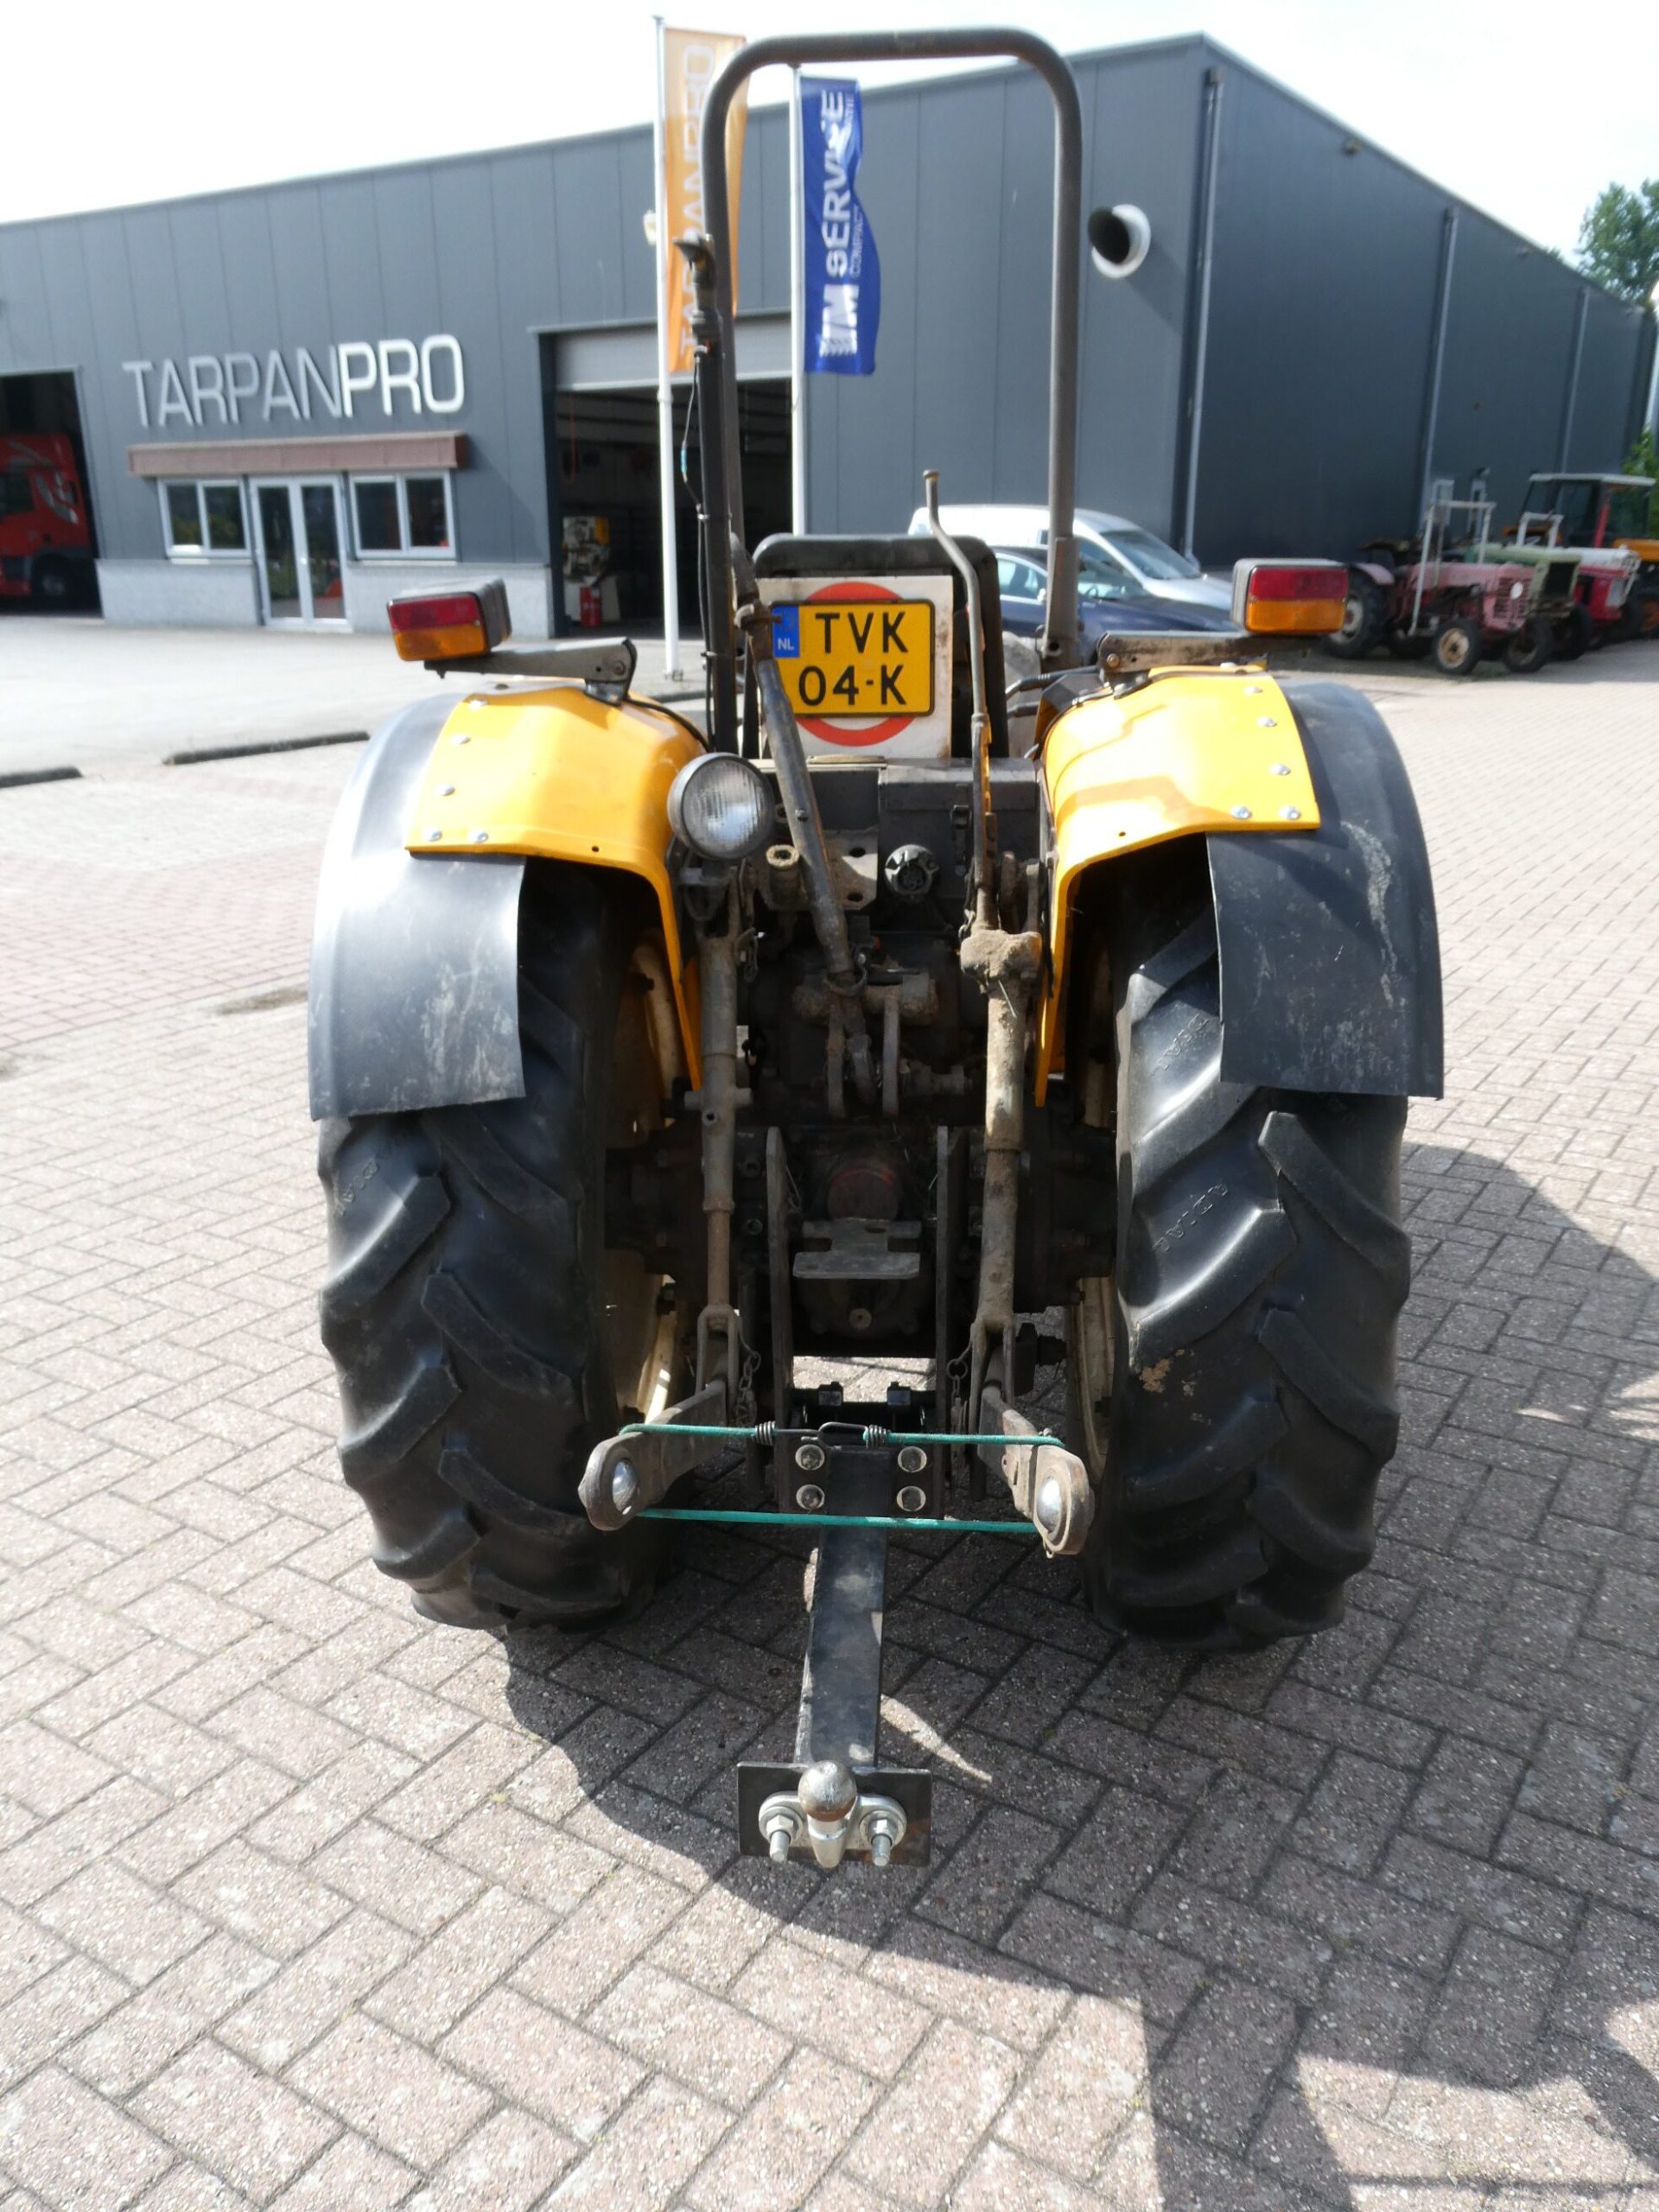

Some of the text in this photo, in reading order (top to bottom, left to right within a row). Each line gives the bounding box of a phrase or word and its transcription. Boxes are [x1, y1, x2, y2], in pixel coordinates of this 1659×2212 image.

[122, 334, 464, 428] TARPANPRO
[778, 638, 794, 651] NL
[815, 612, 908, 653] TVK
[798, 664, 906, 706] 04-K
